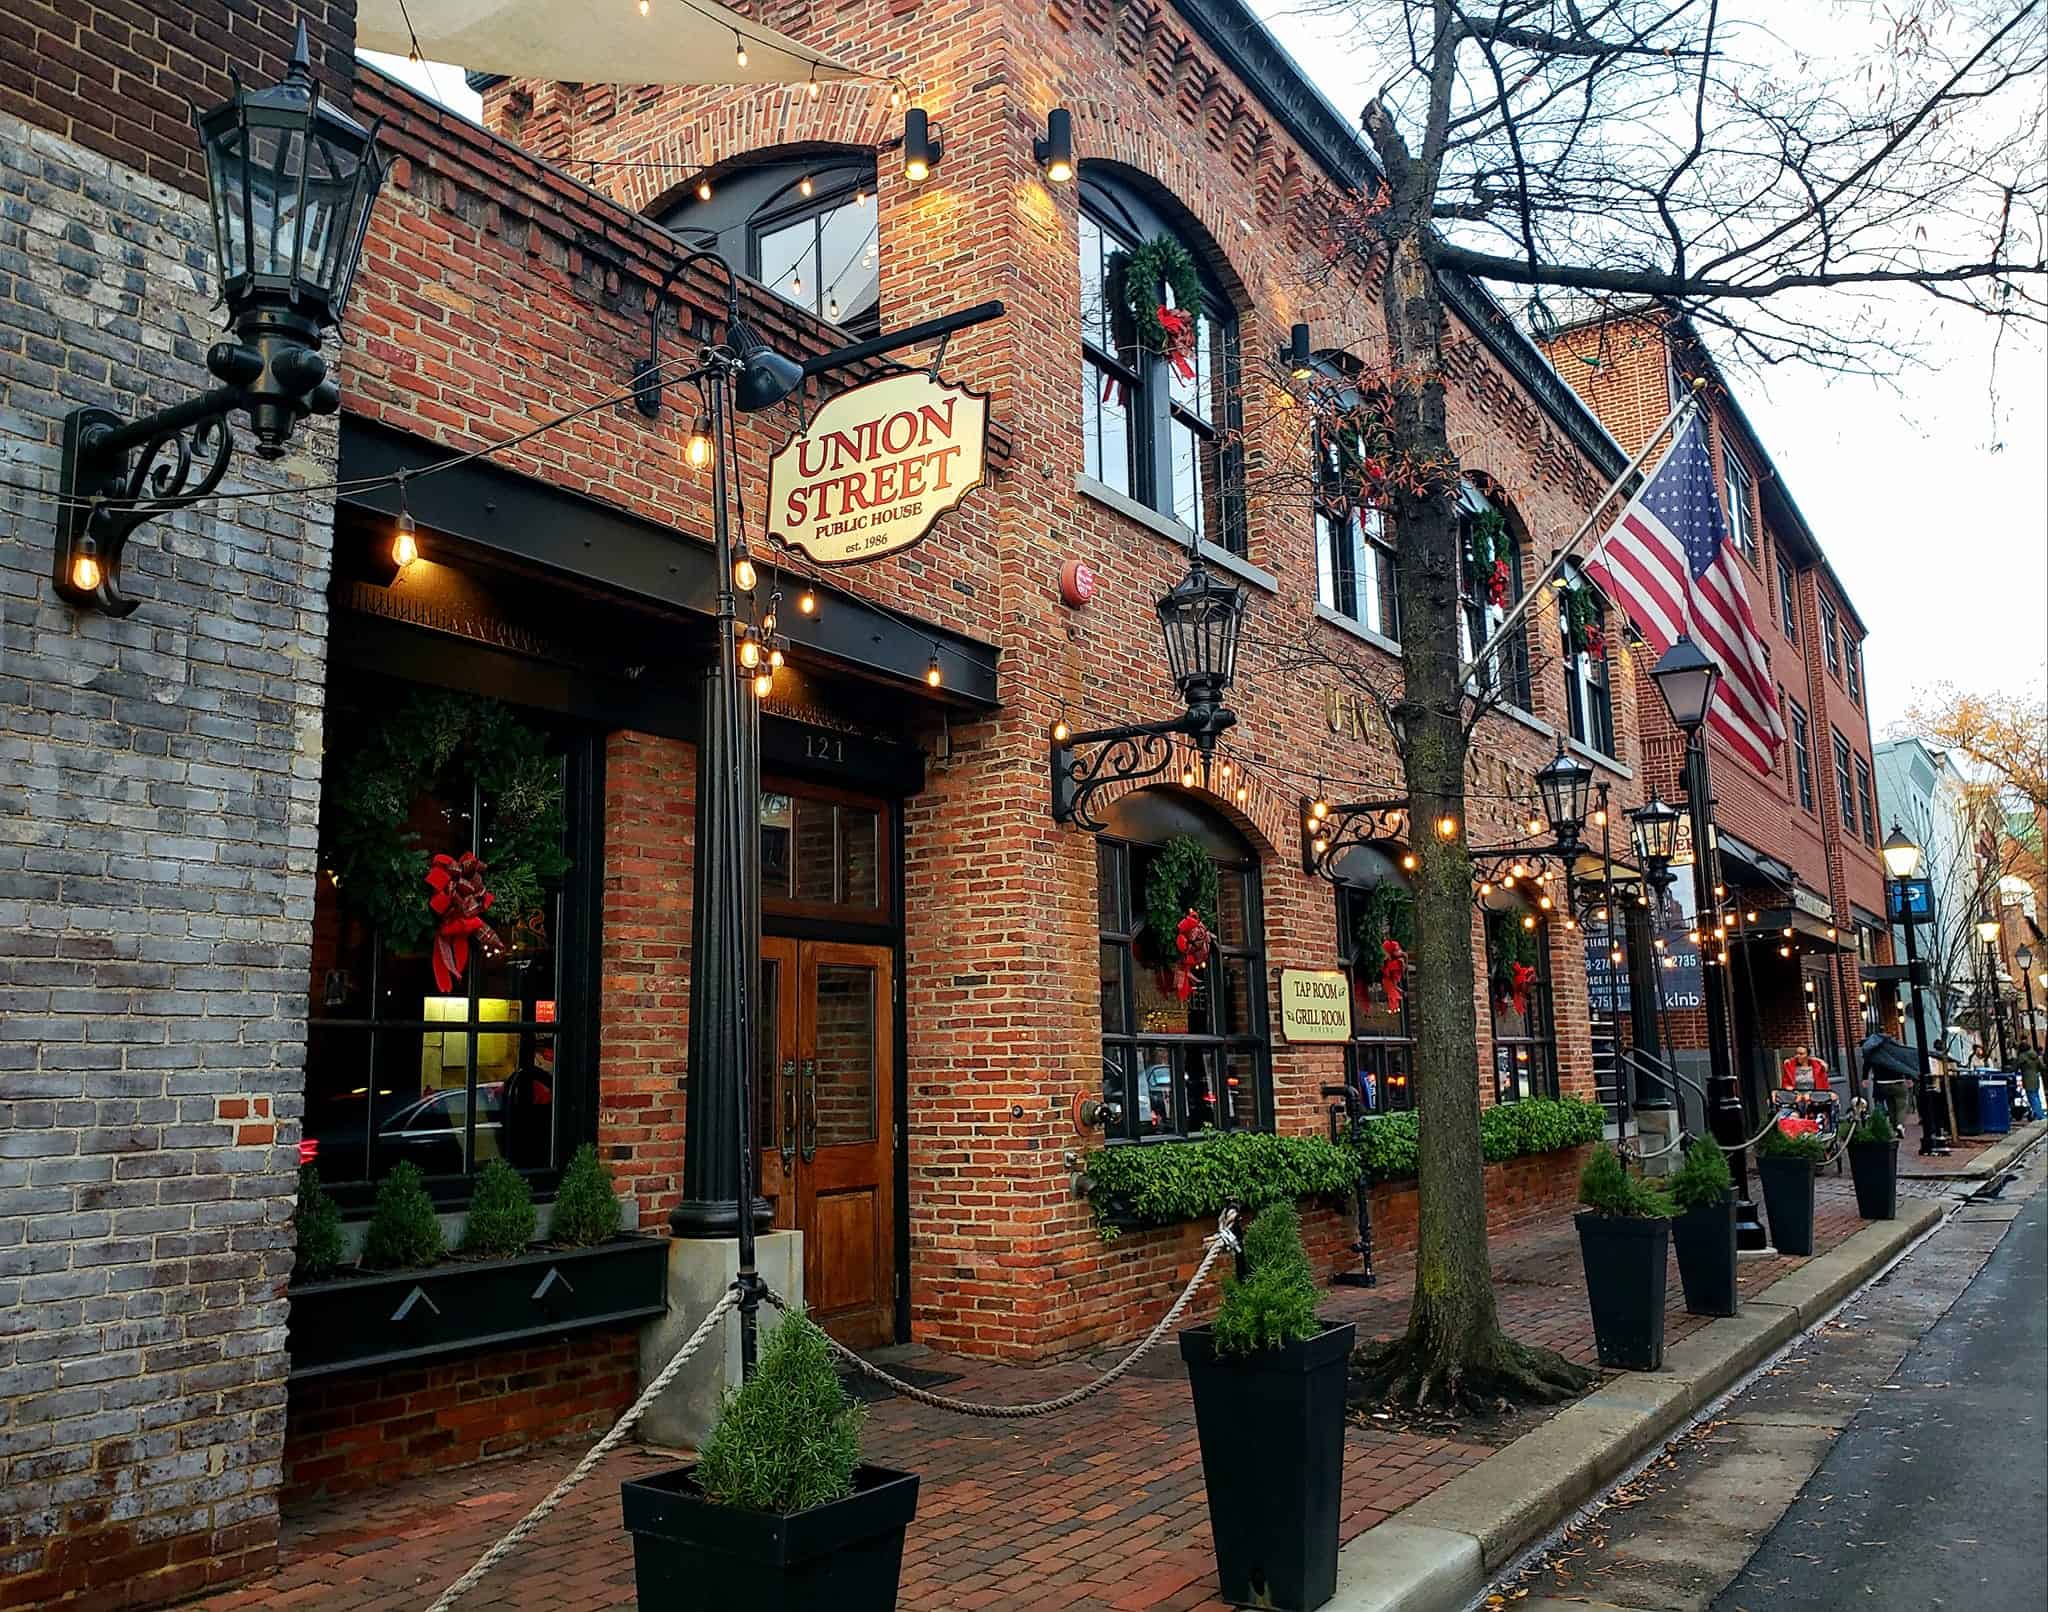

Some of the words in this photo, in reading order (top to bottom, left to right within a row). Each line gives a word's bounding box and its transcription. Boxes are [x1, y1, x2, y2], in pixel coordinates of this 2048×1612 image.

[797, 397, 957, 477] UNION
[786, 445, 960, 526] STREET
[815, 516, 867, 539] PUBLIC
[870, 502, 922, 527] HOUSE
[845, 540, 861, 553] est.
[864, 533, 888, 550] 1986
[806, 736, 844, 762] 121
[1294, 981, 1311, 997] TAP
[1312, 983, 1338, 999] ROOM
[1665, 992, 1700, 1006] klnb
[1295, 1009, 1320, 1024] GRILL
[1320, 1010, 1346, 1026] ROOM
